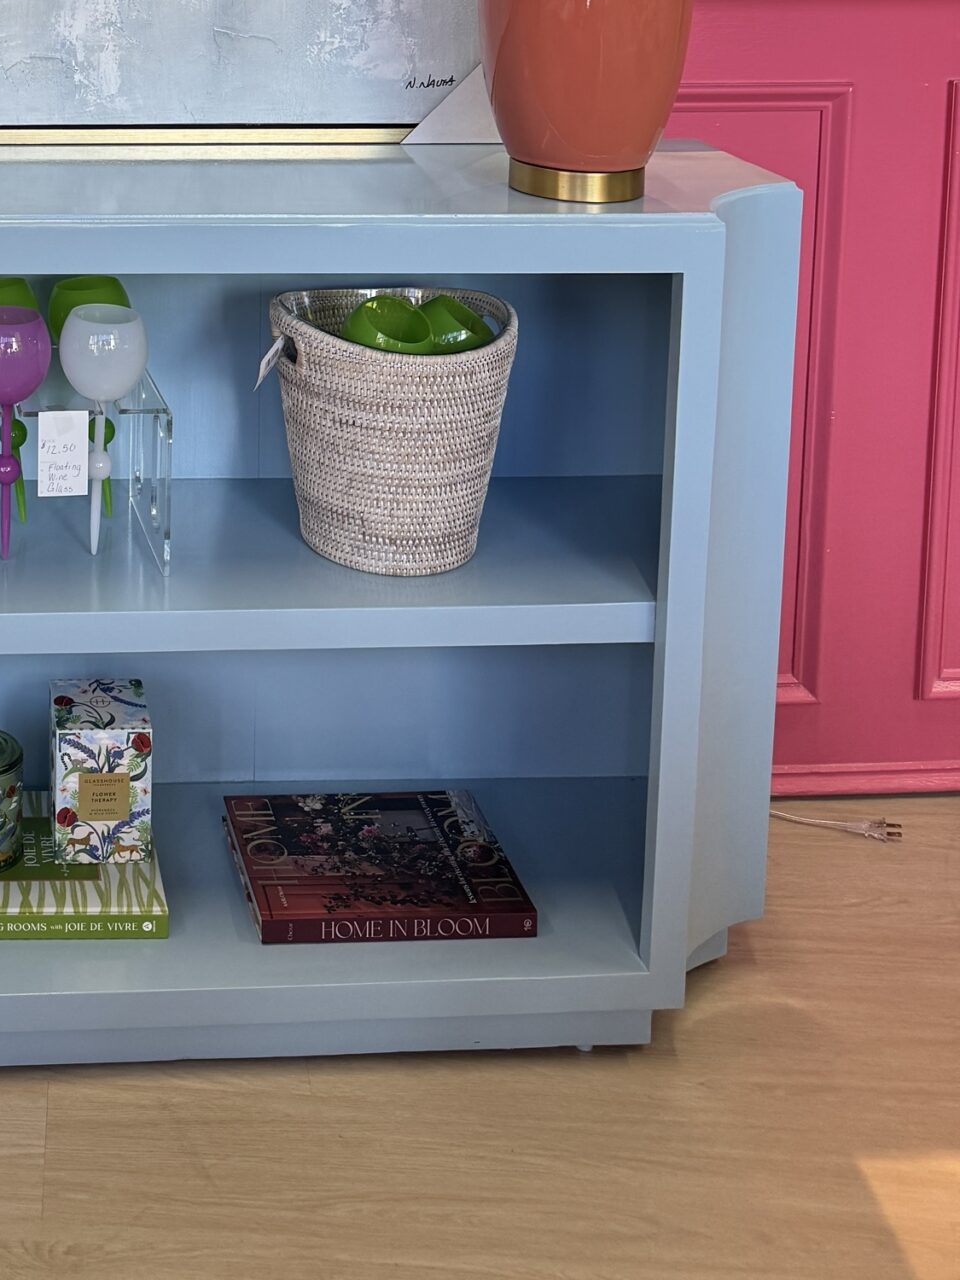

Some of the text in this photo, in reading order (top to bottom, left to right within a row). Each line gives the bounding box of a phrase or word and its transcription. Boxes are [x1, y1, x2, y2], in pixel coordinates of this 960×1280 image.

[40, 442, 77, 455] $12.50
[48, 462, 82, 477] Floating
[48, 473, 68, 482] Wine
[46, 481, 74, 493] Glass
[340, 794, 382, 819] IN
[22, 830, 40, 867] JOIE DE
[231, 797, 298, 886] HOME
[428, 793, 524, 903] BLOOM
[7, 922, 47, 932] ROOMS
[64, 922, 87, 933] JOIE
[89, 922, 104, 932] DE
[107, 922, 139, 932] VIVRE
[321, 917, 490, 940] HOME IN BLOOM
